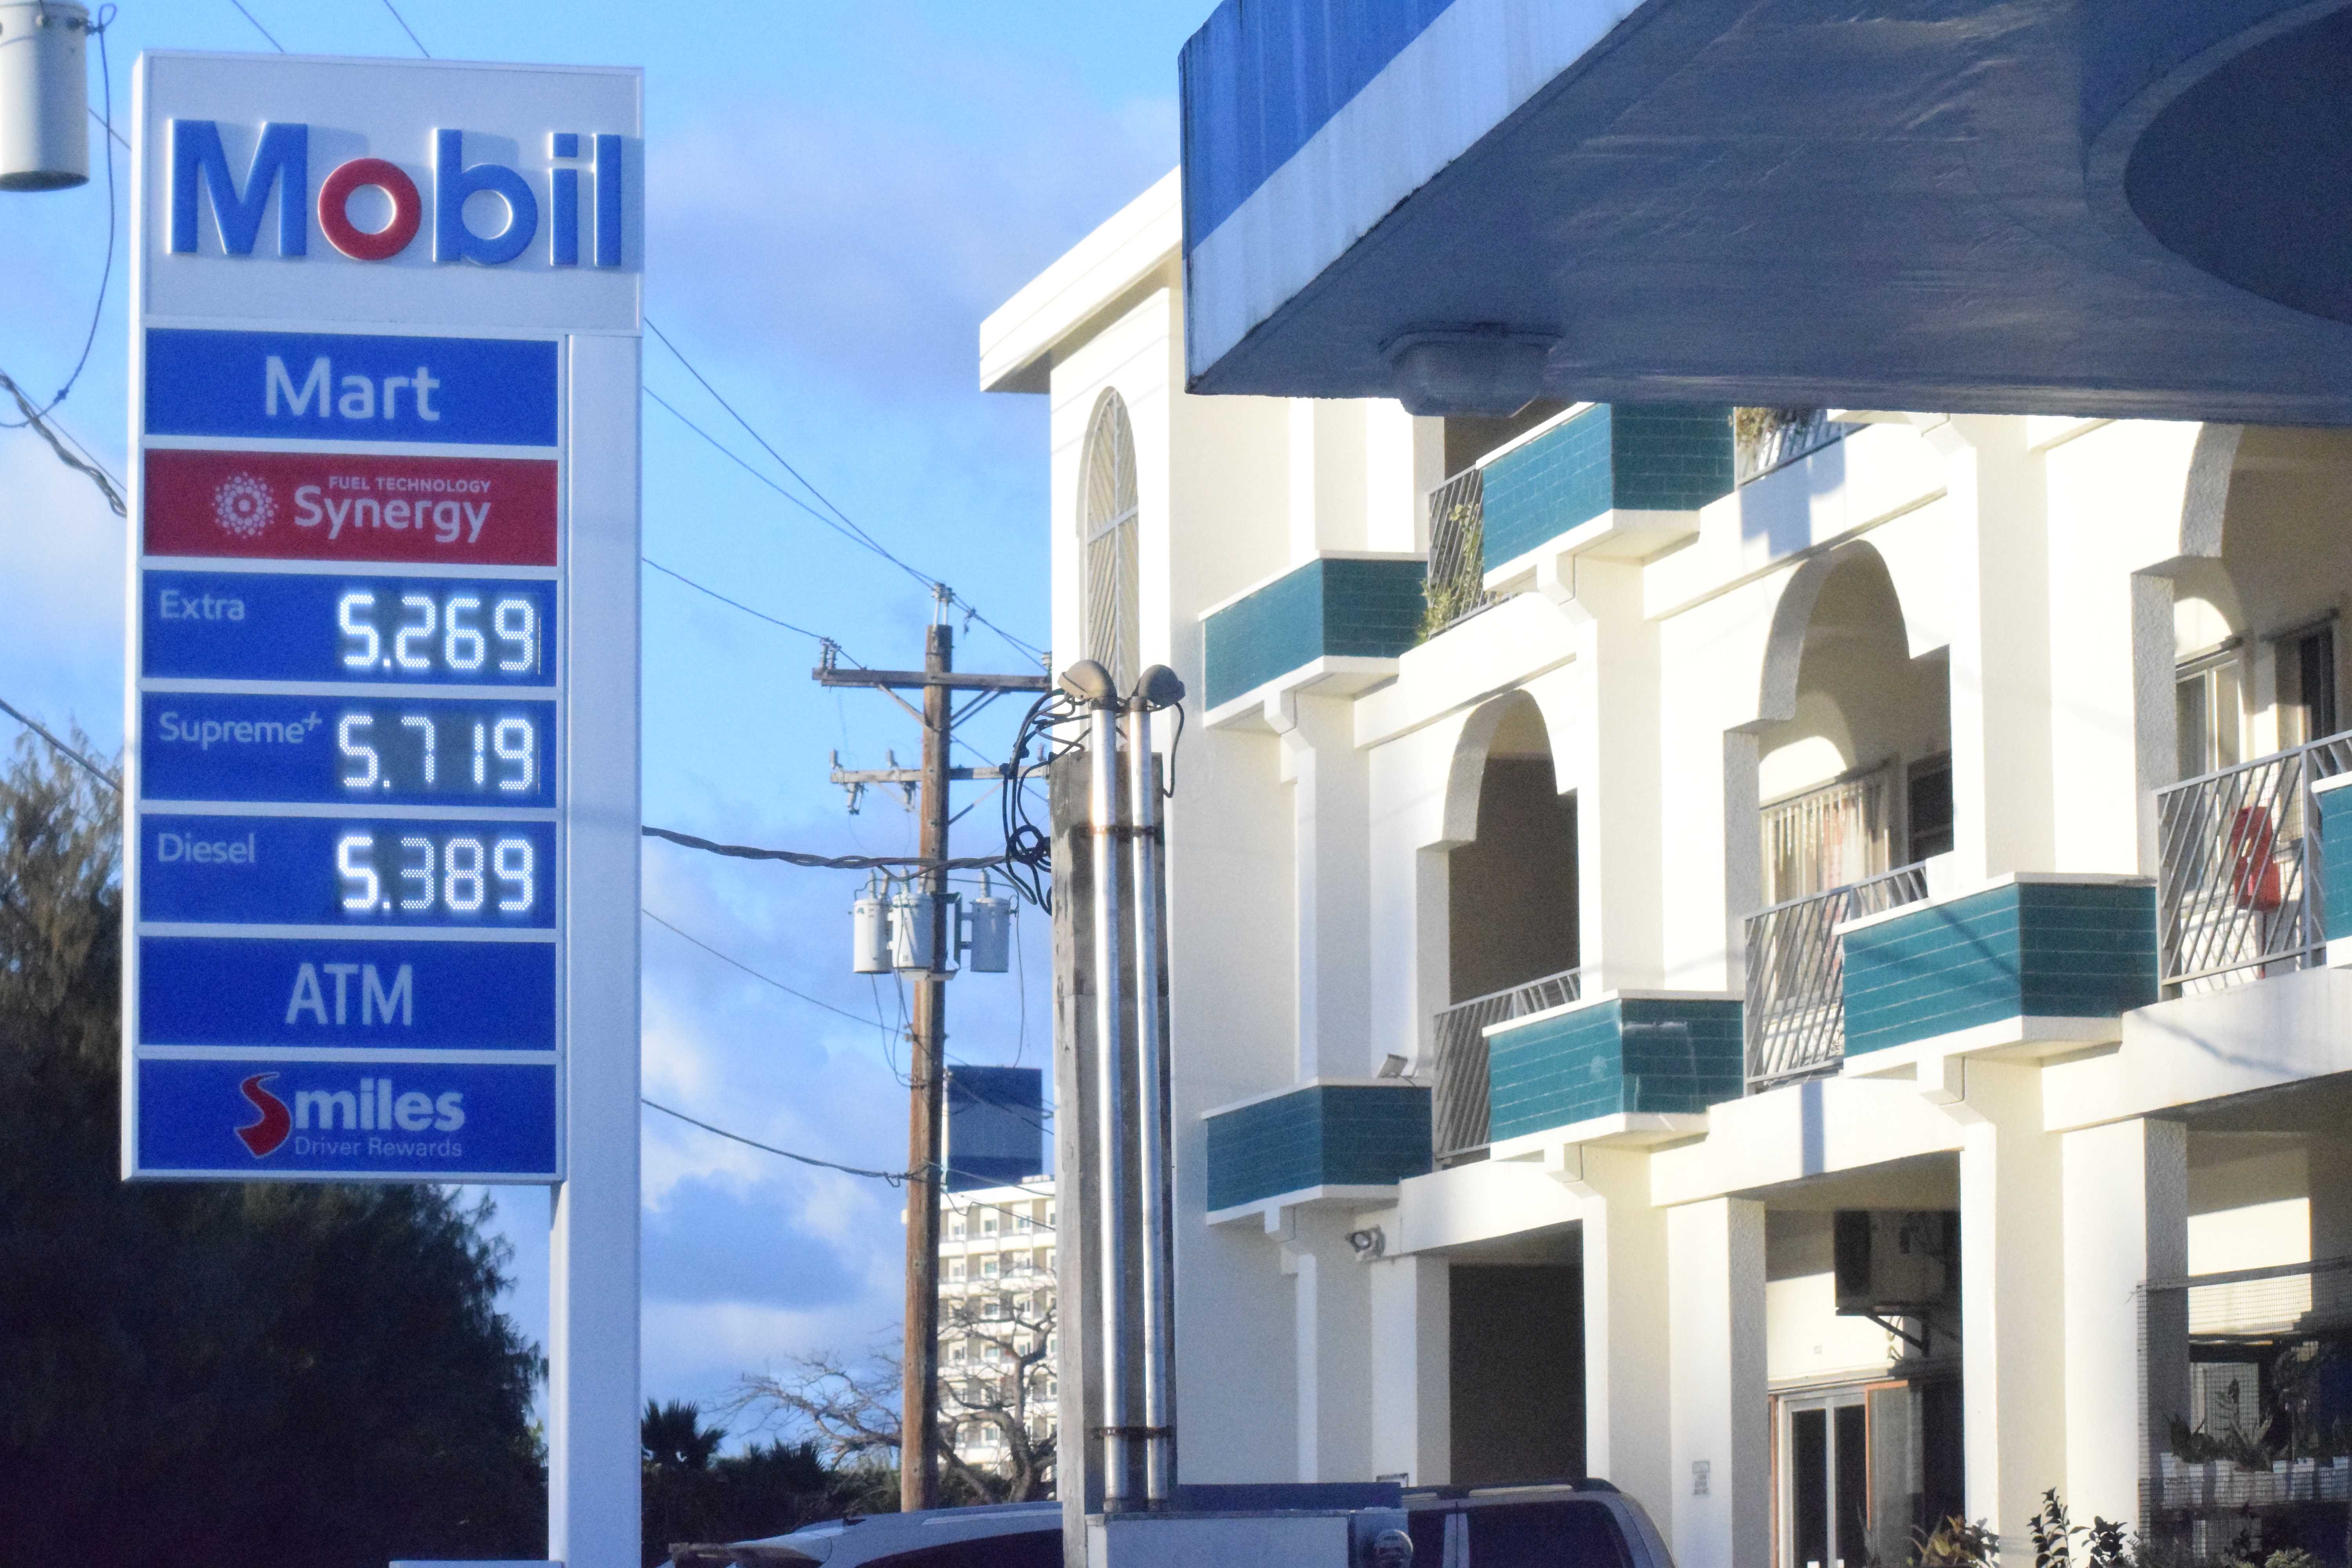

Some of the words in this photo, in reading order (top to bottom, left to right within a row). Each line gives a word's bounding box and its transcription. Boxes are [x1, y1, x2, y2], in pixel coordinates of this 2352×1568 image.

[168, 119, 622, 267] Mobil
[265, 356, 440, 421] Mart
[294, 485, 491, 543] Synergy
[328, 475, 370, 490] FUEL
[375, 477, 491, 493] TECHNOLOGY
[160, 590, 245, 621] Extra
[340, 594, 534, 671] 5.269
[339, 715, 533, 790] 5.719
[158, 833, 255, 864] Diesel
[339, 836, 533, 911] 5.389
[285, 962, 412, 1026] ATM
[234, 1071, 465, 1160] Smiles
[295, 1137, 361, 1156] Driver
[368, 1137, 463, 1158] Rewards
